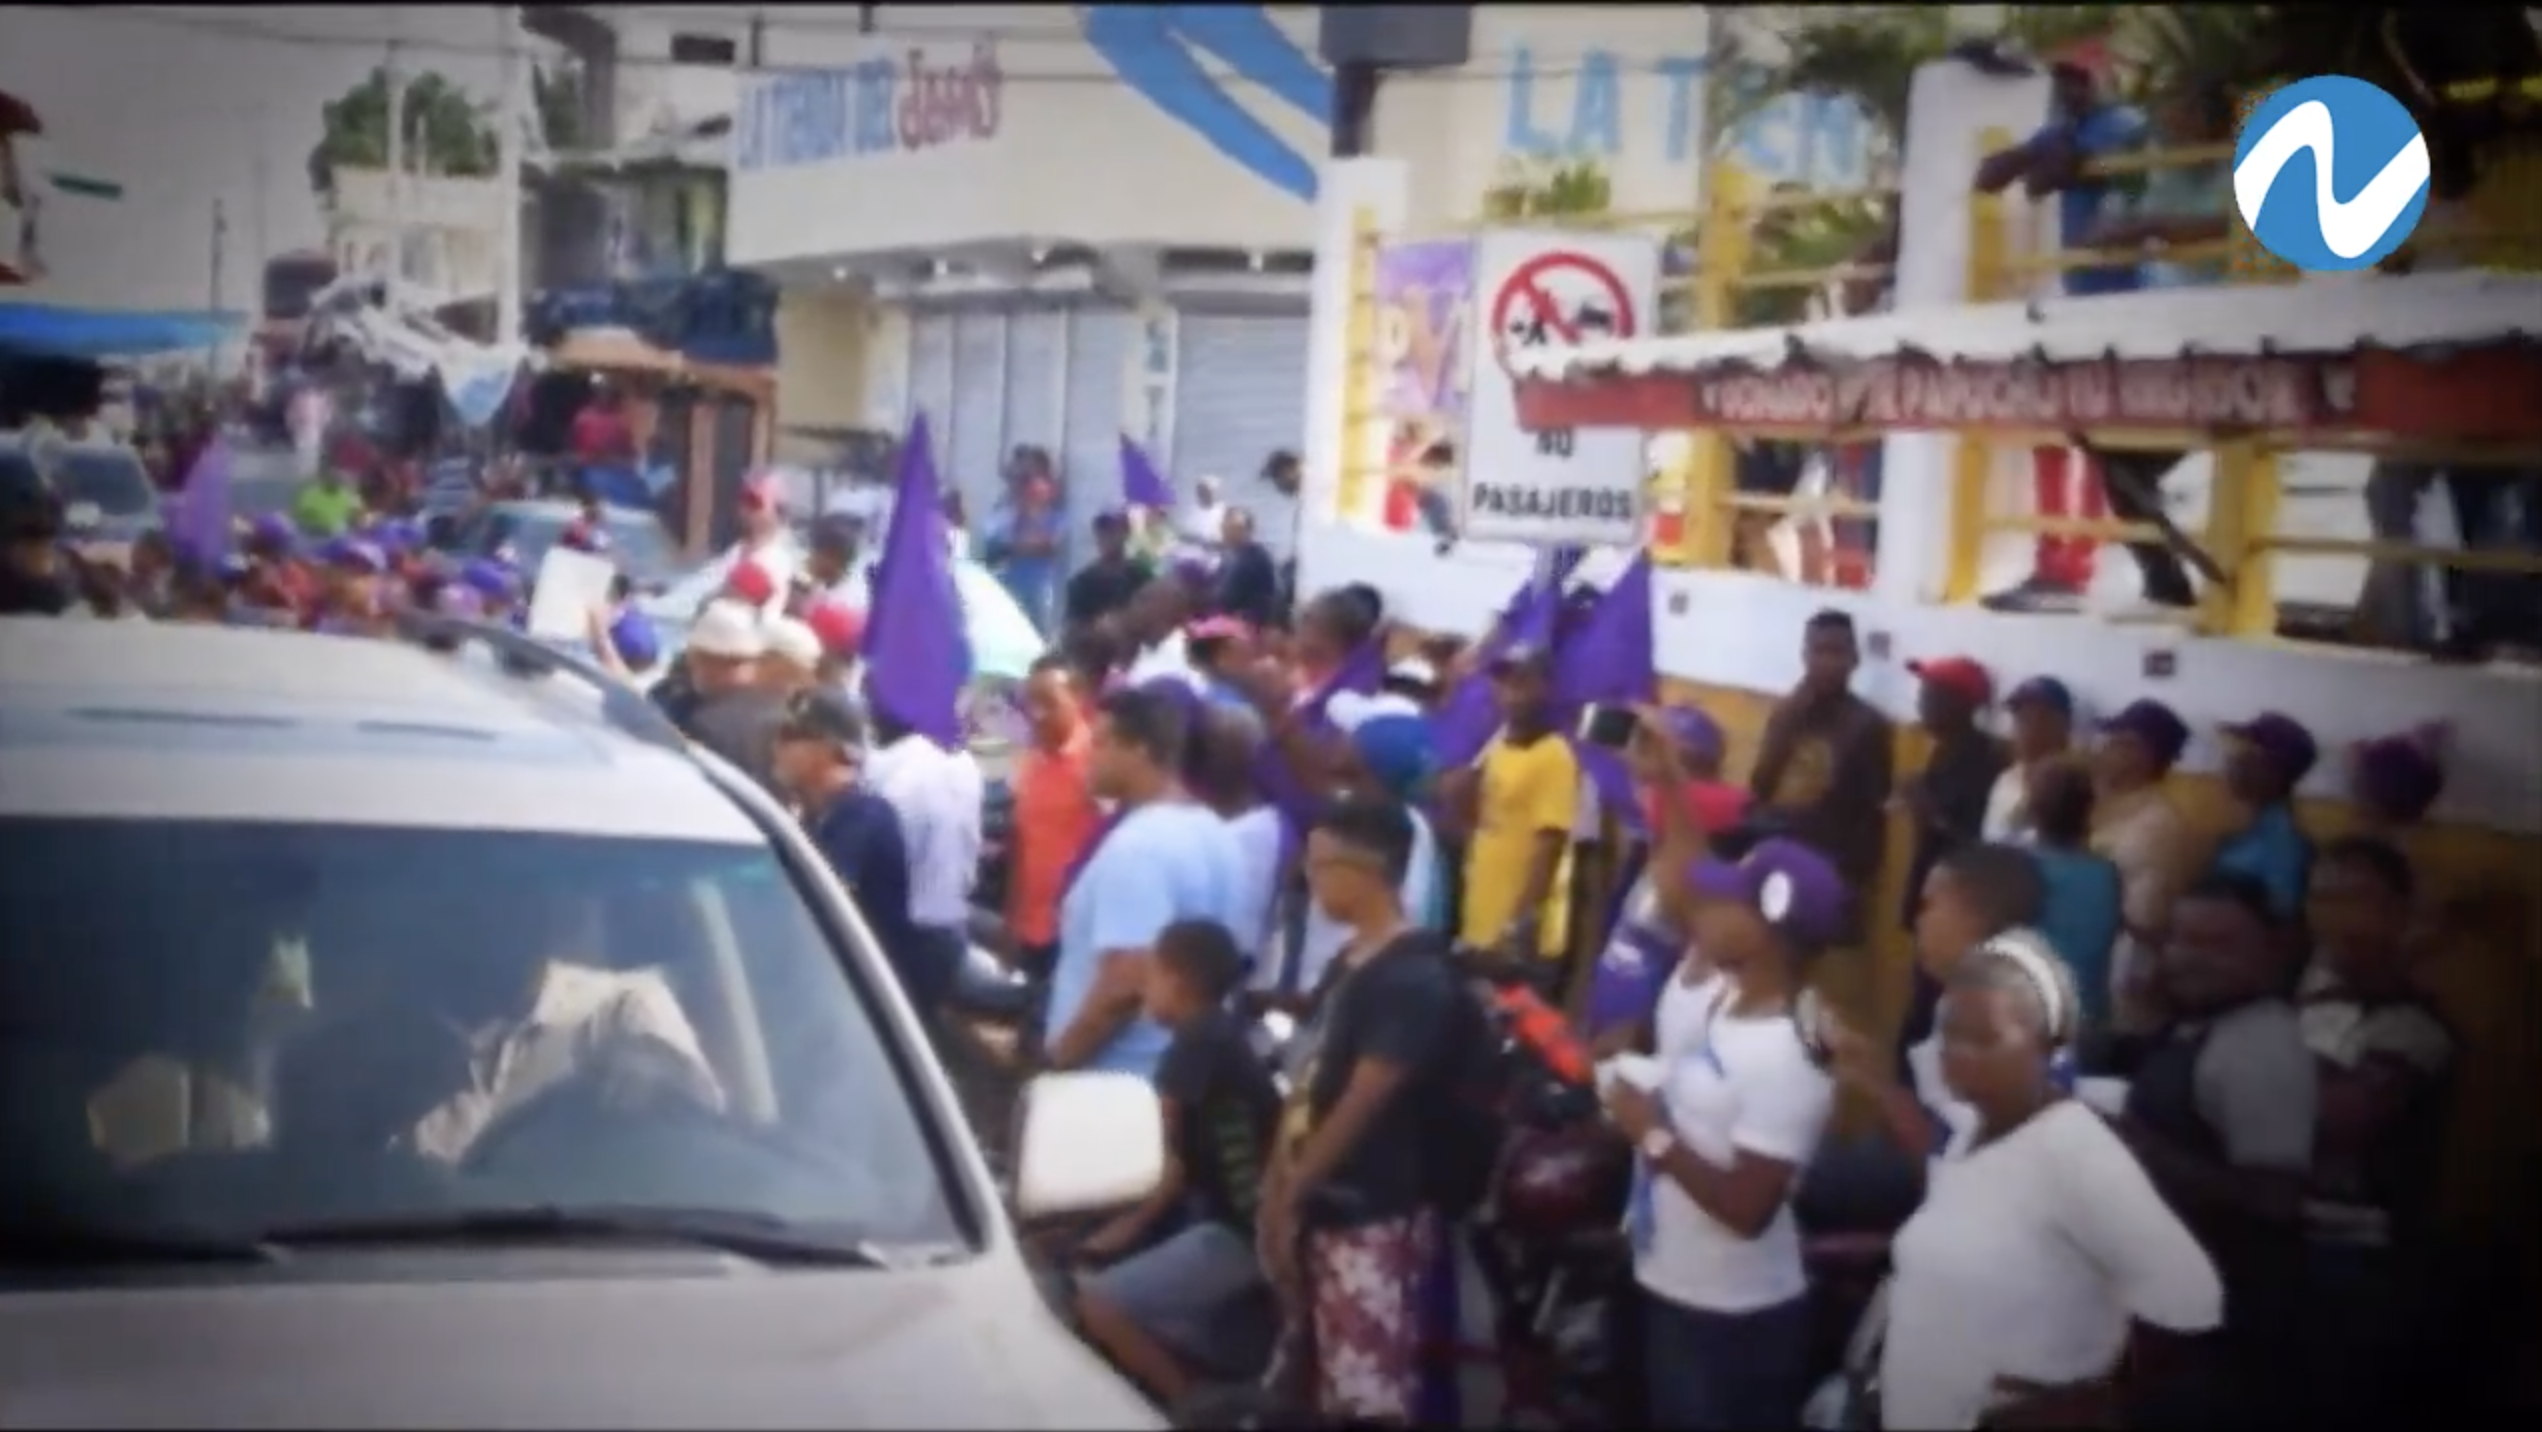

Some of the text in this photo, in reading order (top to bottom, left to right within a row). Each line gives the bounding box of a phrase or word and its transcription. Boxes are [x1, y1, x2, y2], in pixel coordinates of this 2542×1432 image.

[1507, 46, 1622, 155] LA
[1537, 427, 1573, 456] NO
[1473, 483, 1633, 521] PASAJEROS
